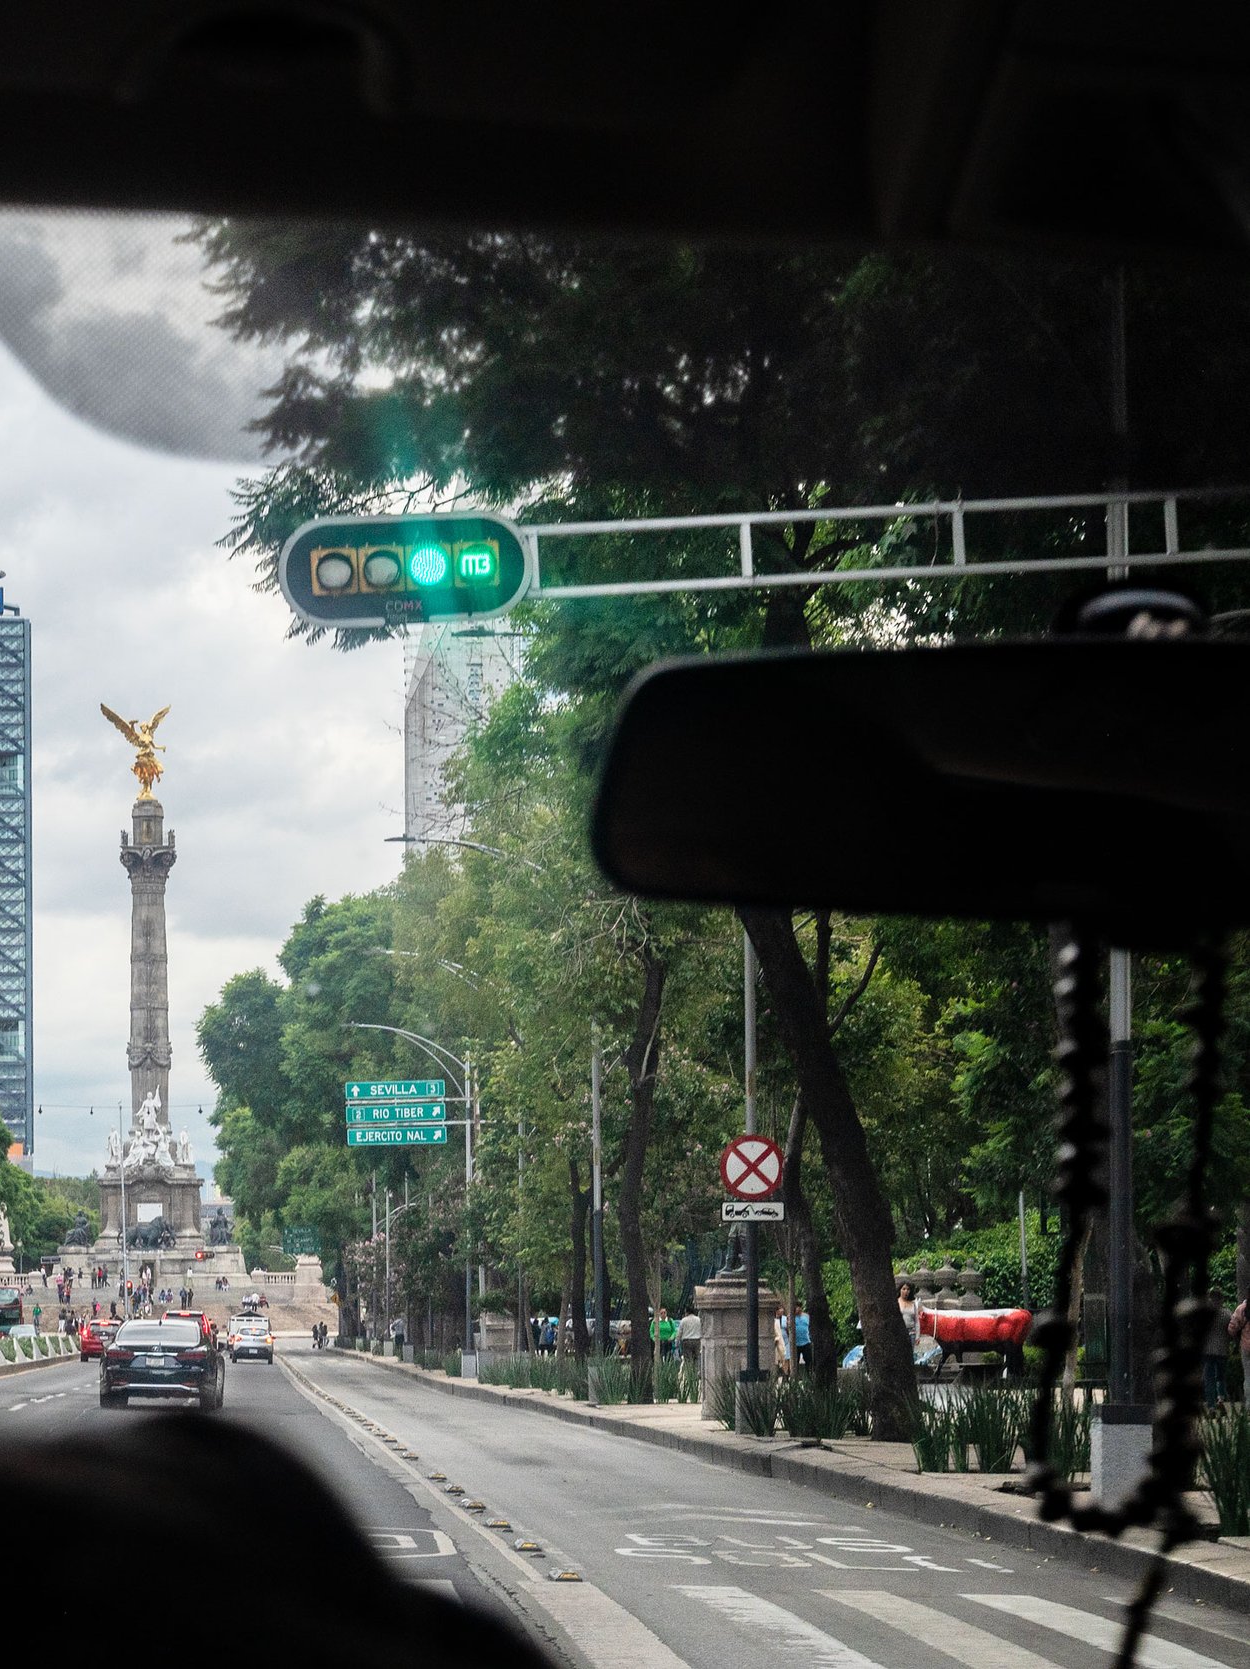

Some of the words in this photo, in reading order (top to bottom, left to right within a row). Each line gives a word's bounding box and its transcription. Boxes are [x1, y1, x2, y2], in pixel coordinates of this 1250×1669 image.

[385, 600, 423, 611] CDMX
[370, 1084, 417, 1095] SEVILLA
[372, 1108, 390, 1119] RIO
[395, 1107, 424, 1118] TIBER
[356, 1131, 402, 1142] EJERCITO
[406, 1130, 427, 1141] NAL
[625, 1533, 914, 1553] BUS
